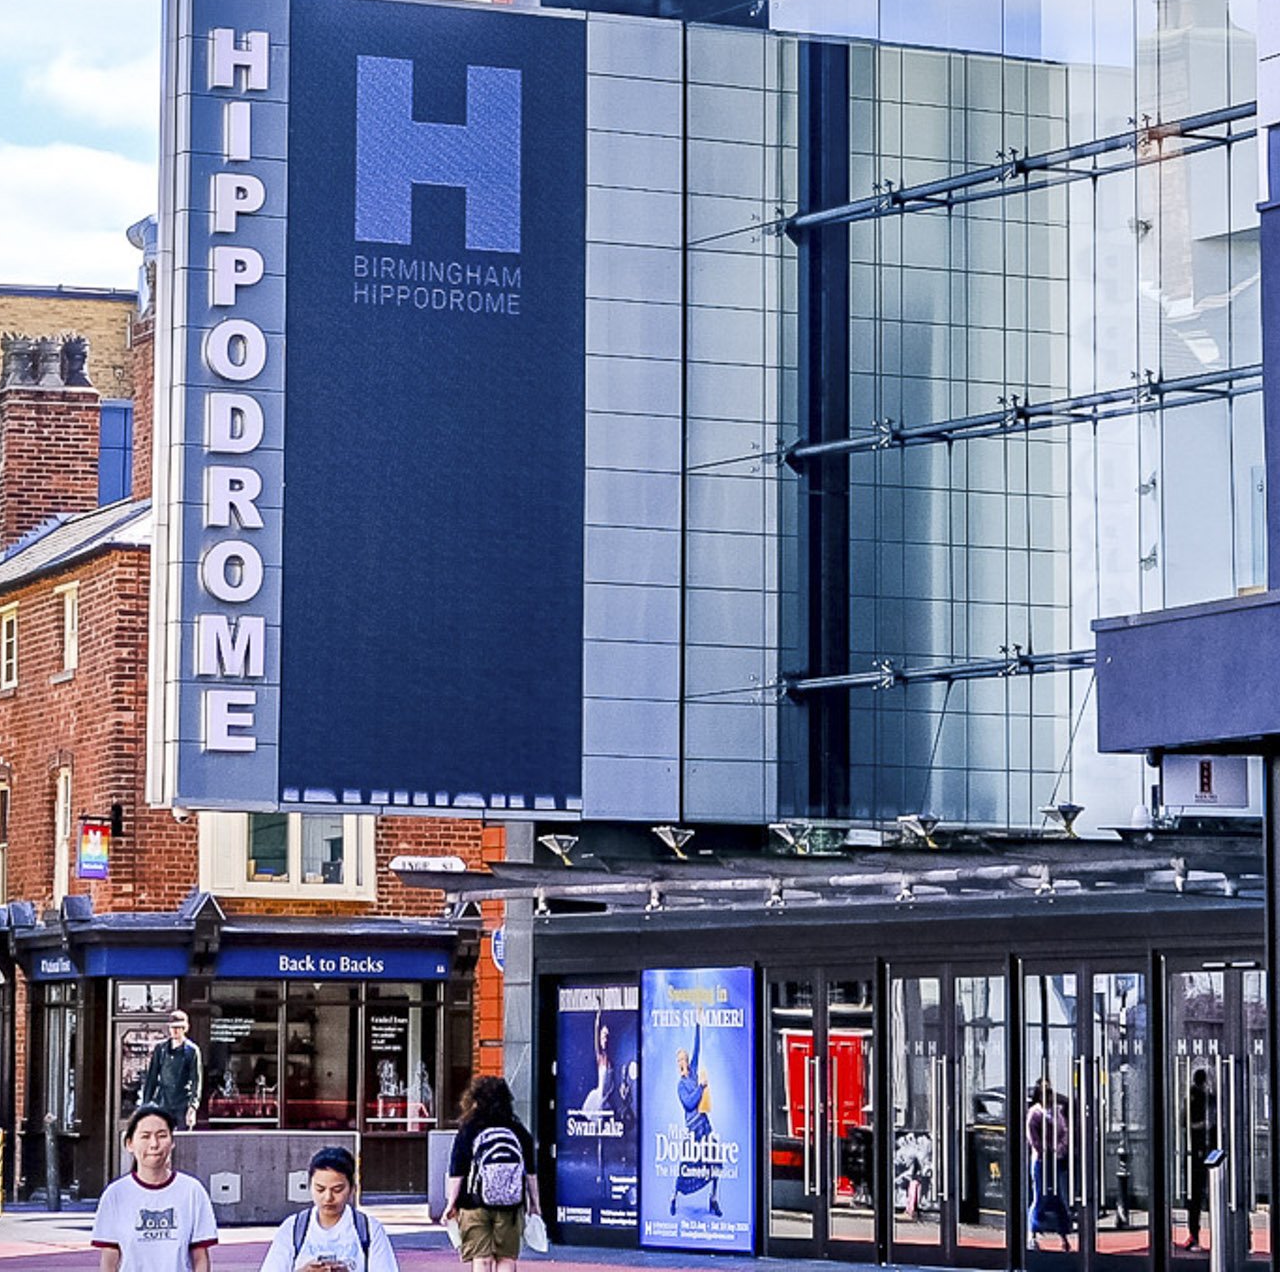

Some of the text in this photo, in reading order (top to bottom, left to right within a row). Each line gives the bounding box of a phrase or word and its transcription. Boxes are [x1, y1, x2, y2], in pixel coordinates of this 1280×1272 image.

[354, 54, 522, 254] H
[353, 255, 521, 288] BIRMINGHAM
[353, 282, 521, 315] HIPPODROME
[194, 27, 270, 752] HIPPODROME
[278, 954, 384, 973] Back to Backs
[651, 1009, 681, 1028] THIS
[567, 1117, 624, 1137] Swan Lake
[655, 1130, 740, 1165] Doubtfire
[143, 1230, 171, 1239] CUTE
